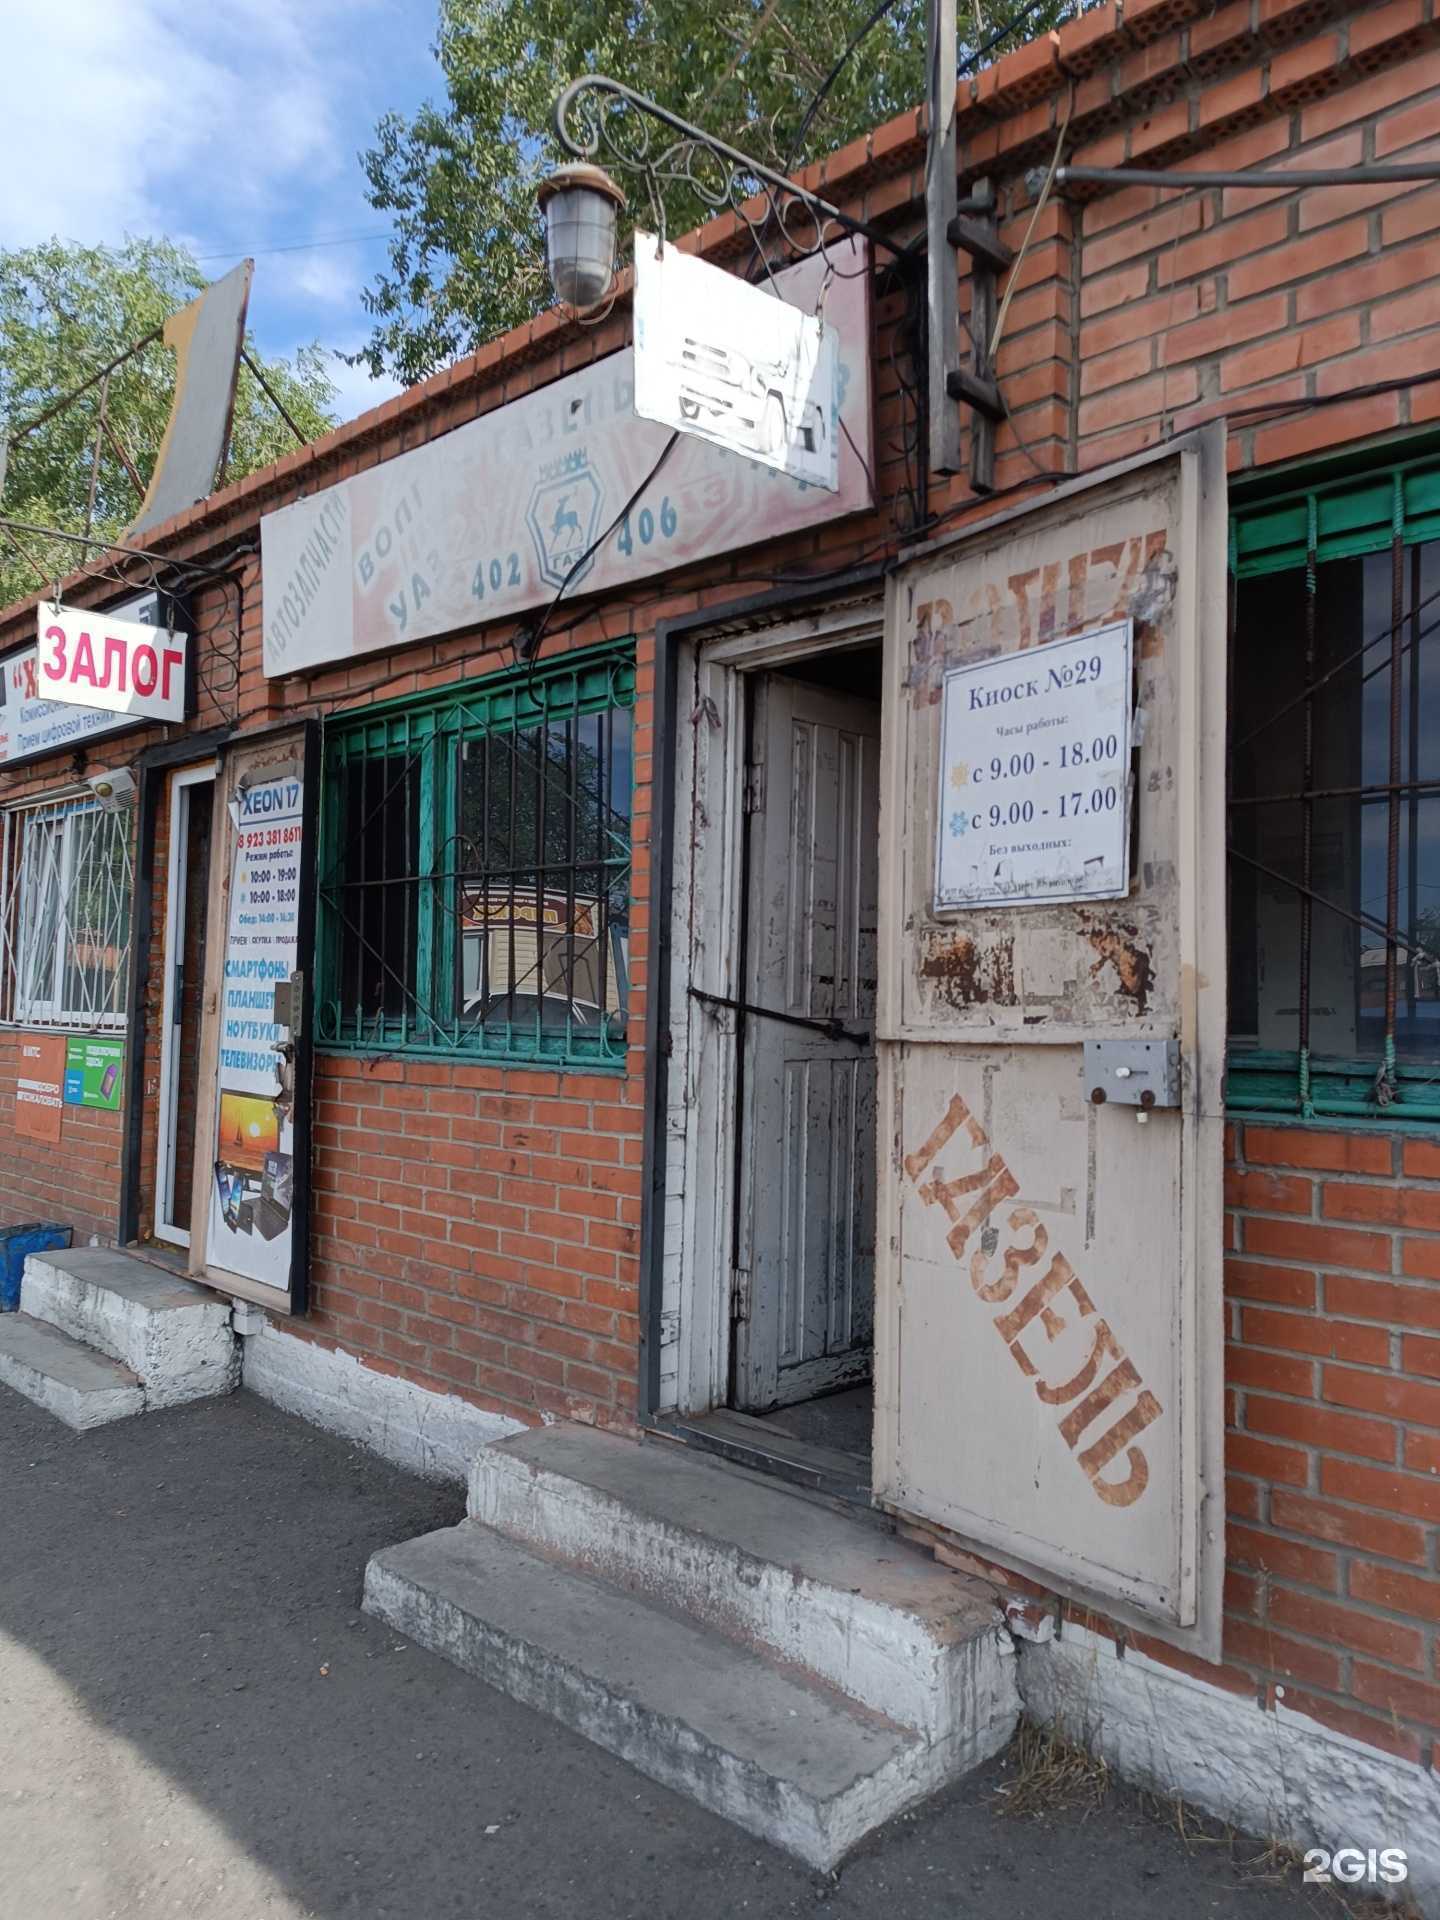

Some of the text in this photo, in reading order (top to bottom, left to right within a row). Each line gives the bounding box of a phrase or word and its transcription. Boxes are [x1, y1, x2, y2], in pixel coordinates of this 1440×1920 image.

[617, 496, 677, 556] 406
[265, 489, 346, 662] АВТОЗАПЧАСТИ
[471, 552, 521, 600] 402
[44, 626, 183, 700] ЗАЛОГ
[968, 656, 1101, 711] Киоск №29
[996, 715, 1069, 737] Часы работы:
[972, 766, 984, 783] с
[990, 752, 1034, 780] 9.00
[1059, 734, 1117, 768] 18.00
[243, 783, 299, 815] XEON 17
[971, 813, 983, 829] с
[989, 800, 1034, 827] 9.00
[1058, 786, 1117, 818] 17.00
[247, 831, 263, 848] 923
[989, 844, 1008, 856] Без
[250, 869, 271, 884] 10:00
[277, 867, 296, 882] 19:00
[249, 890, 270, 904] 10:00
[225, 957, 289, 981] СМАРТФОНЫ
[227, 990, 275, 1010] ПЛАНШЕТ
[904, 1093, 1163, 1507] ГАЗЕЛЬ
